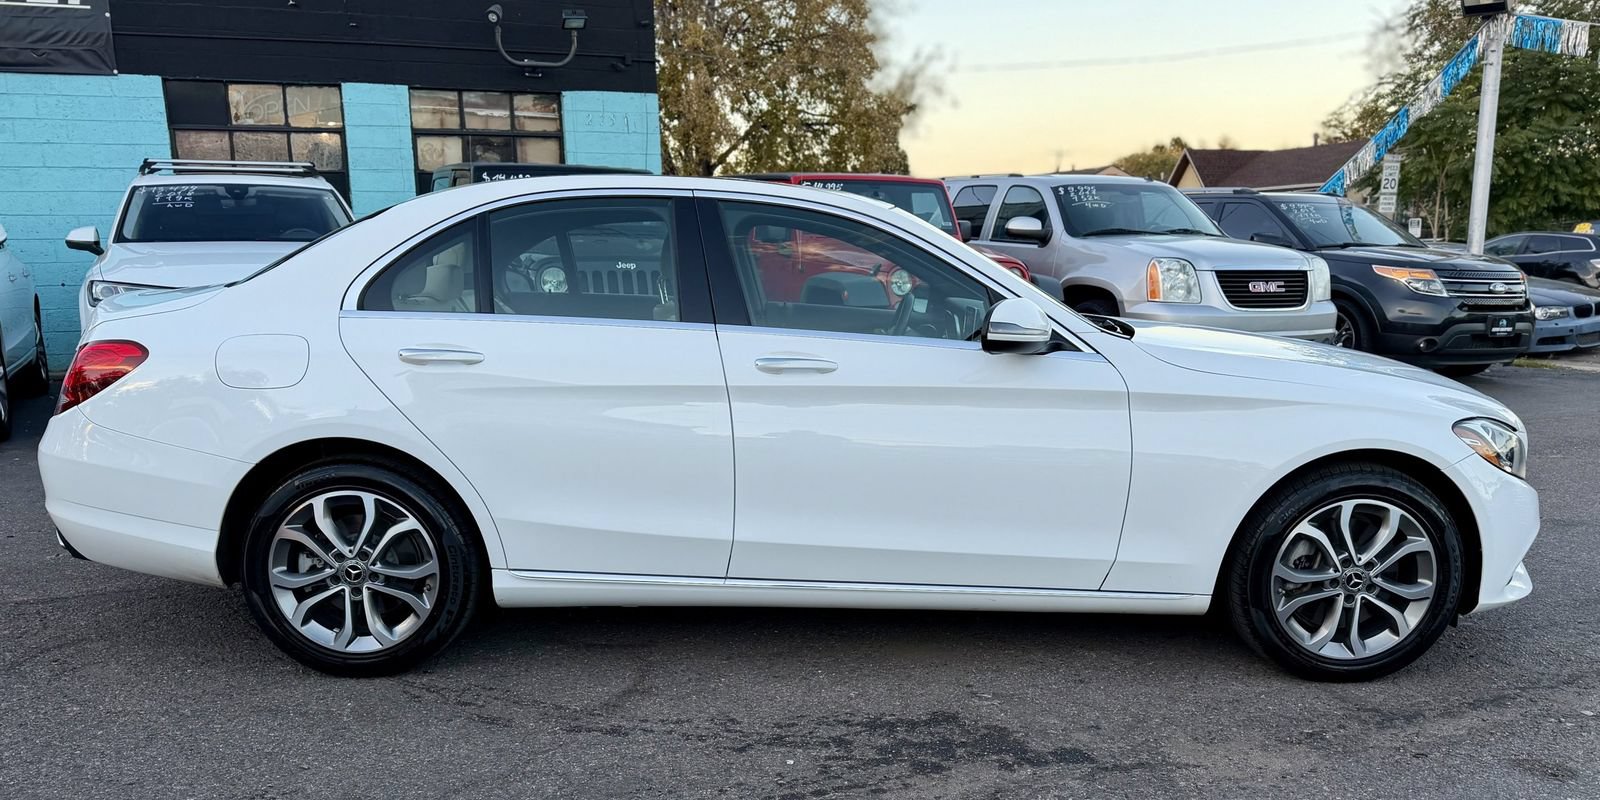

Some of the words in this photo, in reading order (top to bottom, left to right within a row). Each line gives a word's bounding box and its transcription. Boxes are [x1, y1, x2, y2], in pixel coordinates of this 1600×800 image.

[246, 95, 311, 121] OPN
[1383, 178, 1397, 190] 20
[616, 261, 637, 270] Jeep
[1249, 281, 1286, 293] GMC
